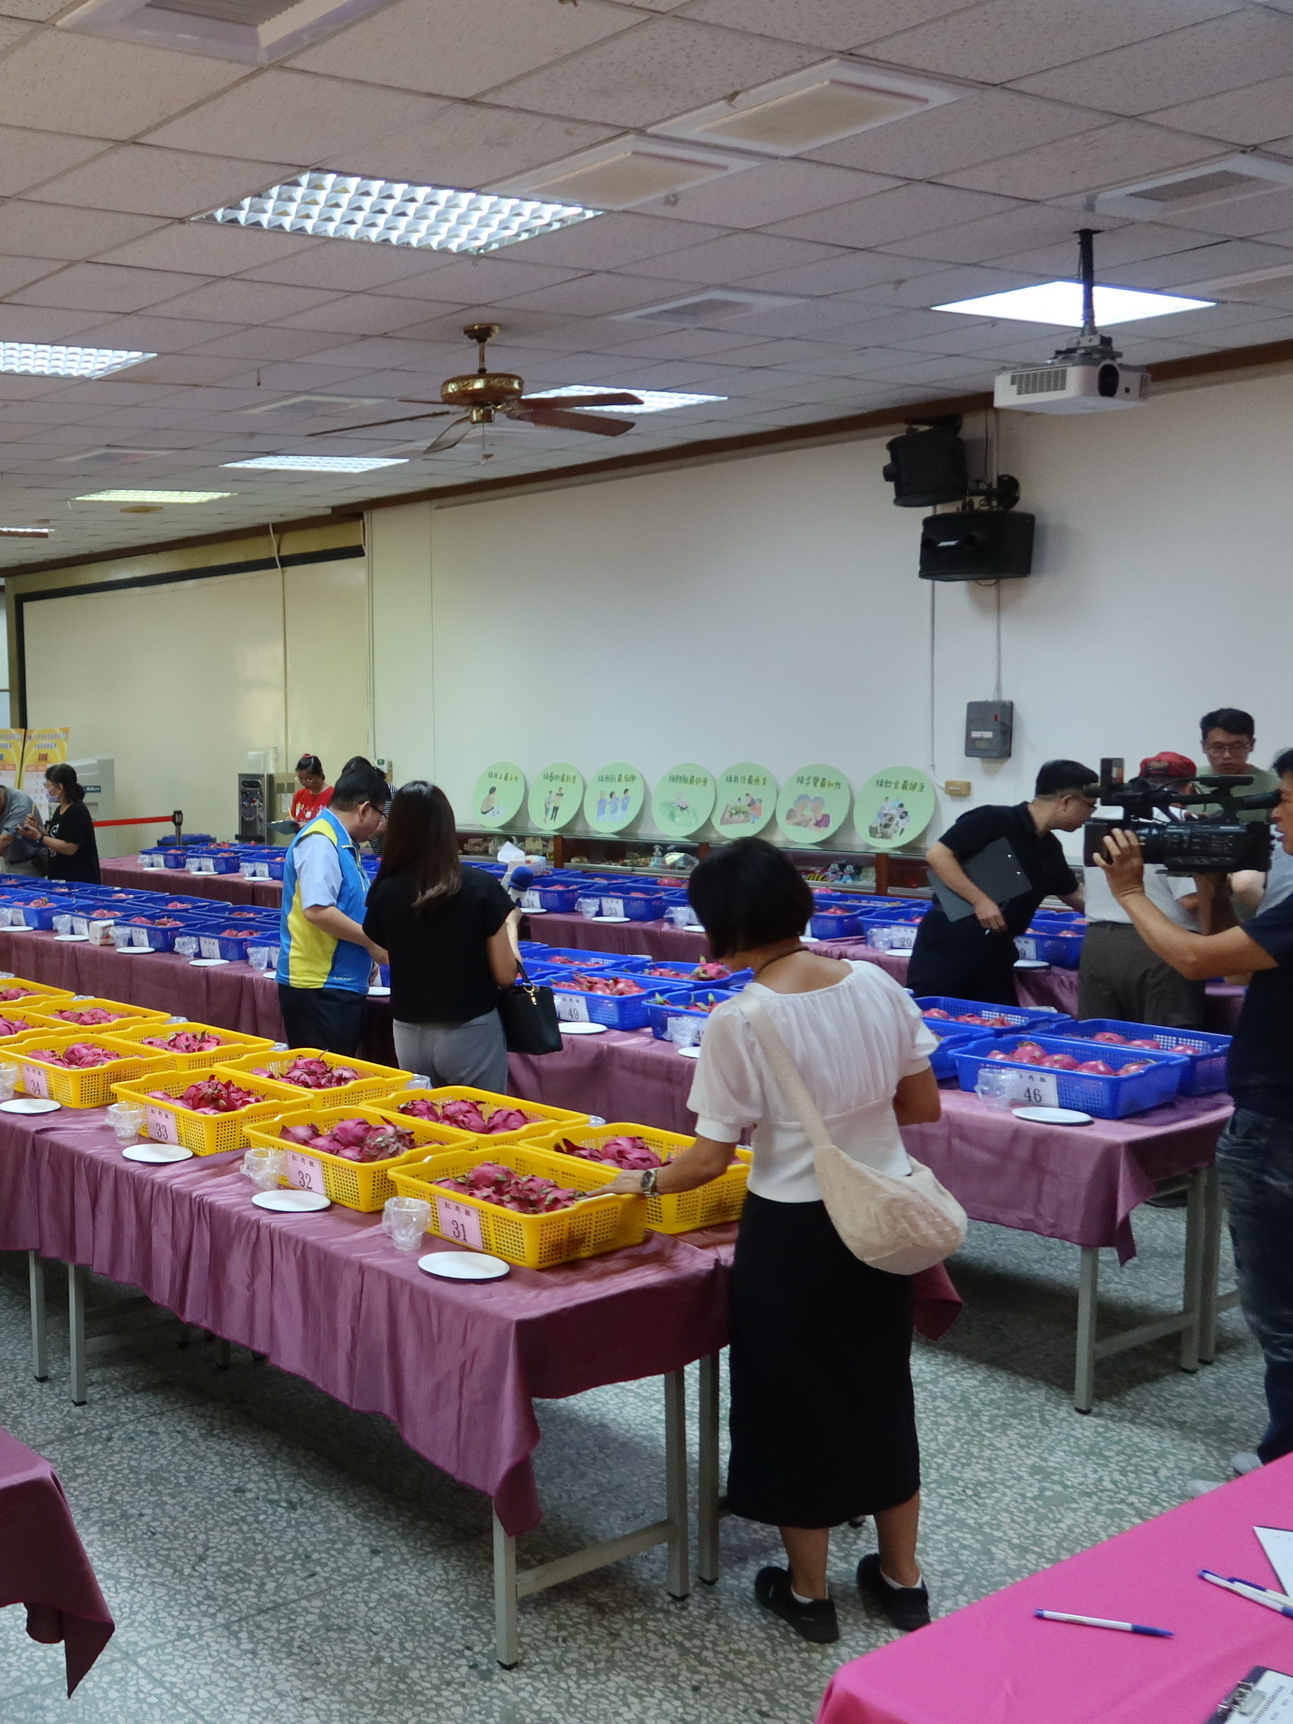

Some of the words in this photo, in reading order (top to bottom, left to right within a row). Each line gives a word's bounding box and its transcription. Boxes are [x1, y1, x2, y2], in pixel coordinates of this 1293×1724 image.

[568, 1007, 580, 1020] 49
[30, 1079, 42, 1095] 34
[1023, 1087, 1043, 1103] 46
[155, 1122, 169, 1140] 33
[297, 1170, 313, 1190] 32
[451, 1219, 467, 1241] 31
